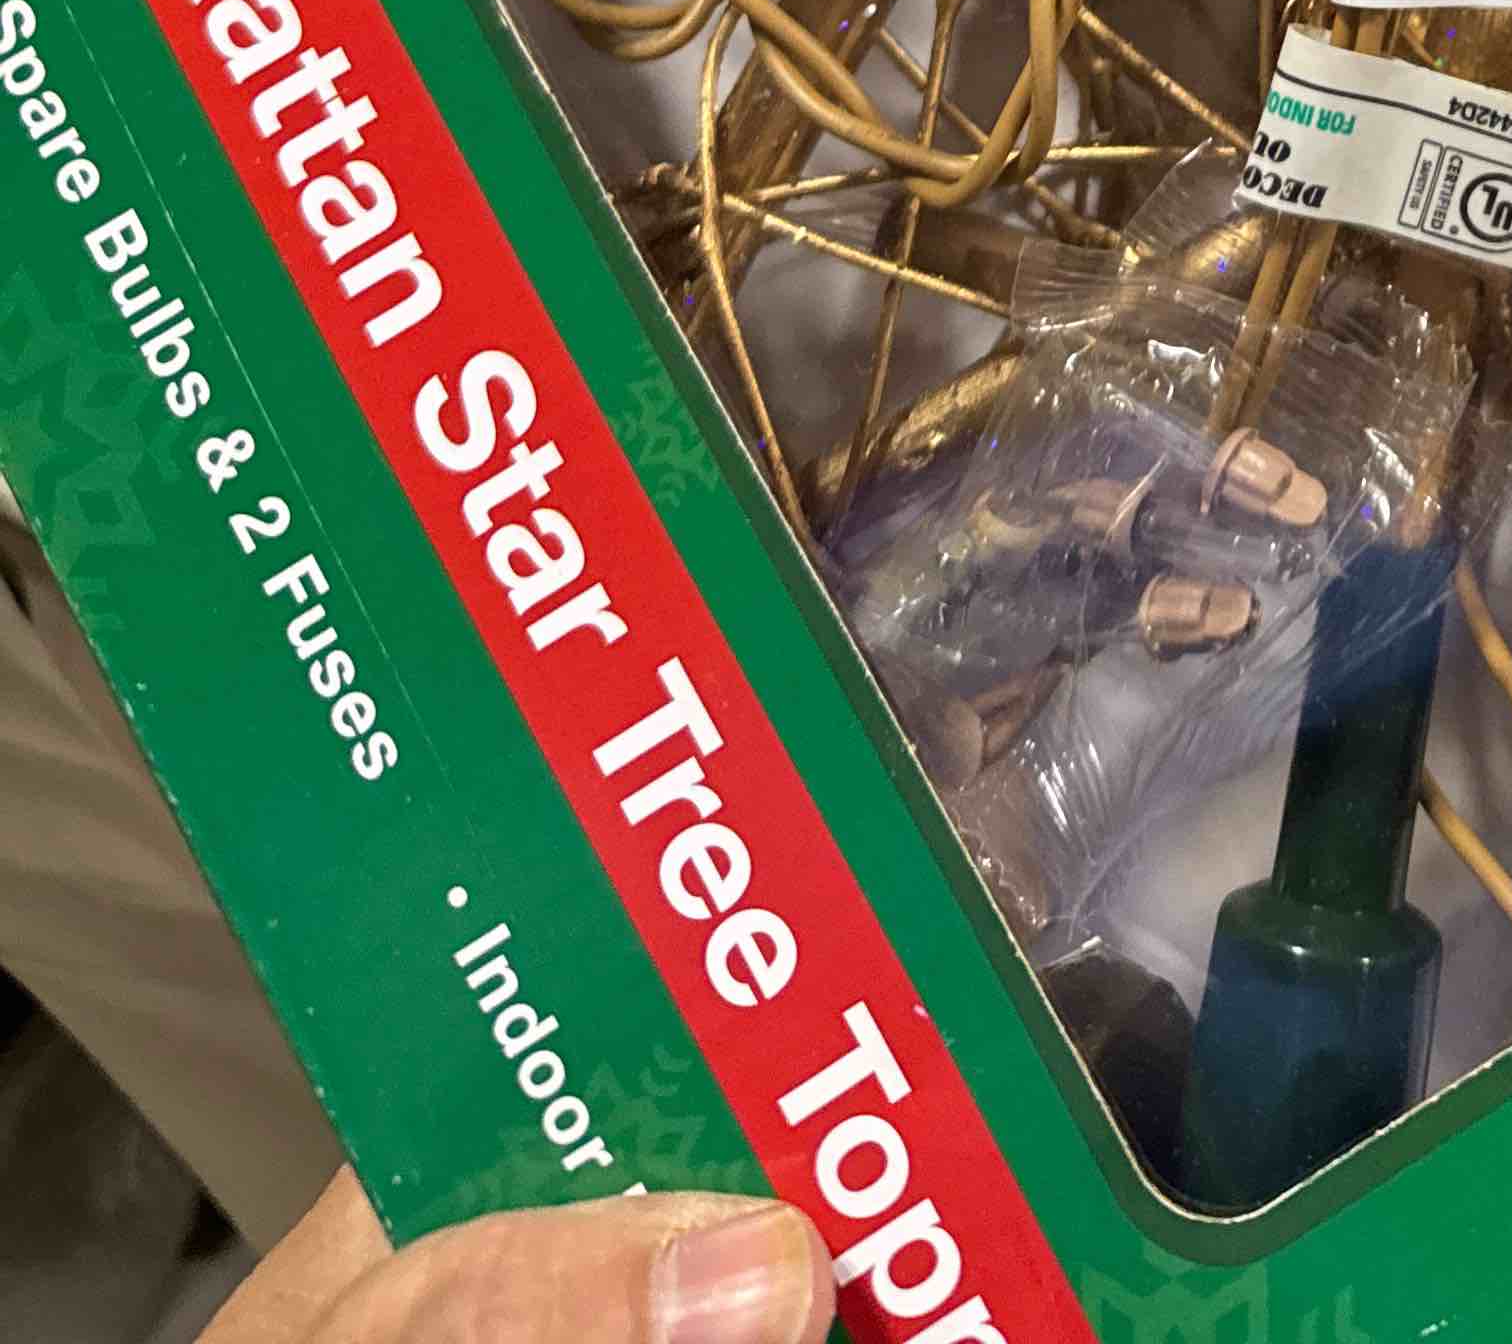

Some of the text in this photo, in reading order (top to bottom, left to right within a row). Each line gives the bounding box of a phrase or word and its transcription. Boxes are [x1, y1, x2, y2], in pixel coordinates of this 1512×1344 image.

[1316, 102, 1357, 135] FOR
[1430, 154, 1463, 229] CERTIFIED
[84, 208, 211, 420] Bulbs
[197, 428, 255, 492] &
[228, 498, 290, 554] 2
[261, 554, 398, 780] Fuses
[414, 348, 629, 654] Star
[592, 657, 799, 1009] Tree
[453, 922, 614, 1171] Indoor
